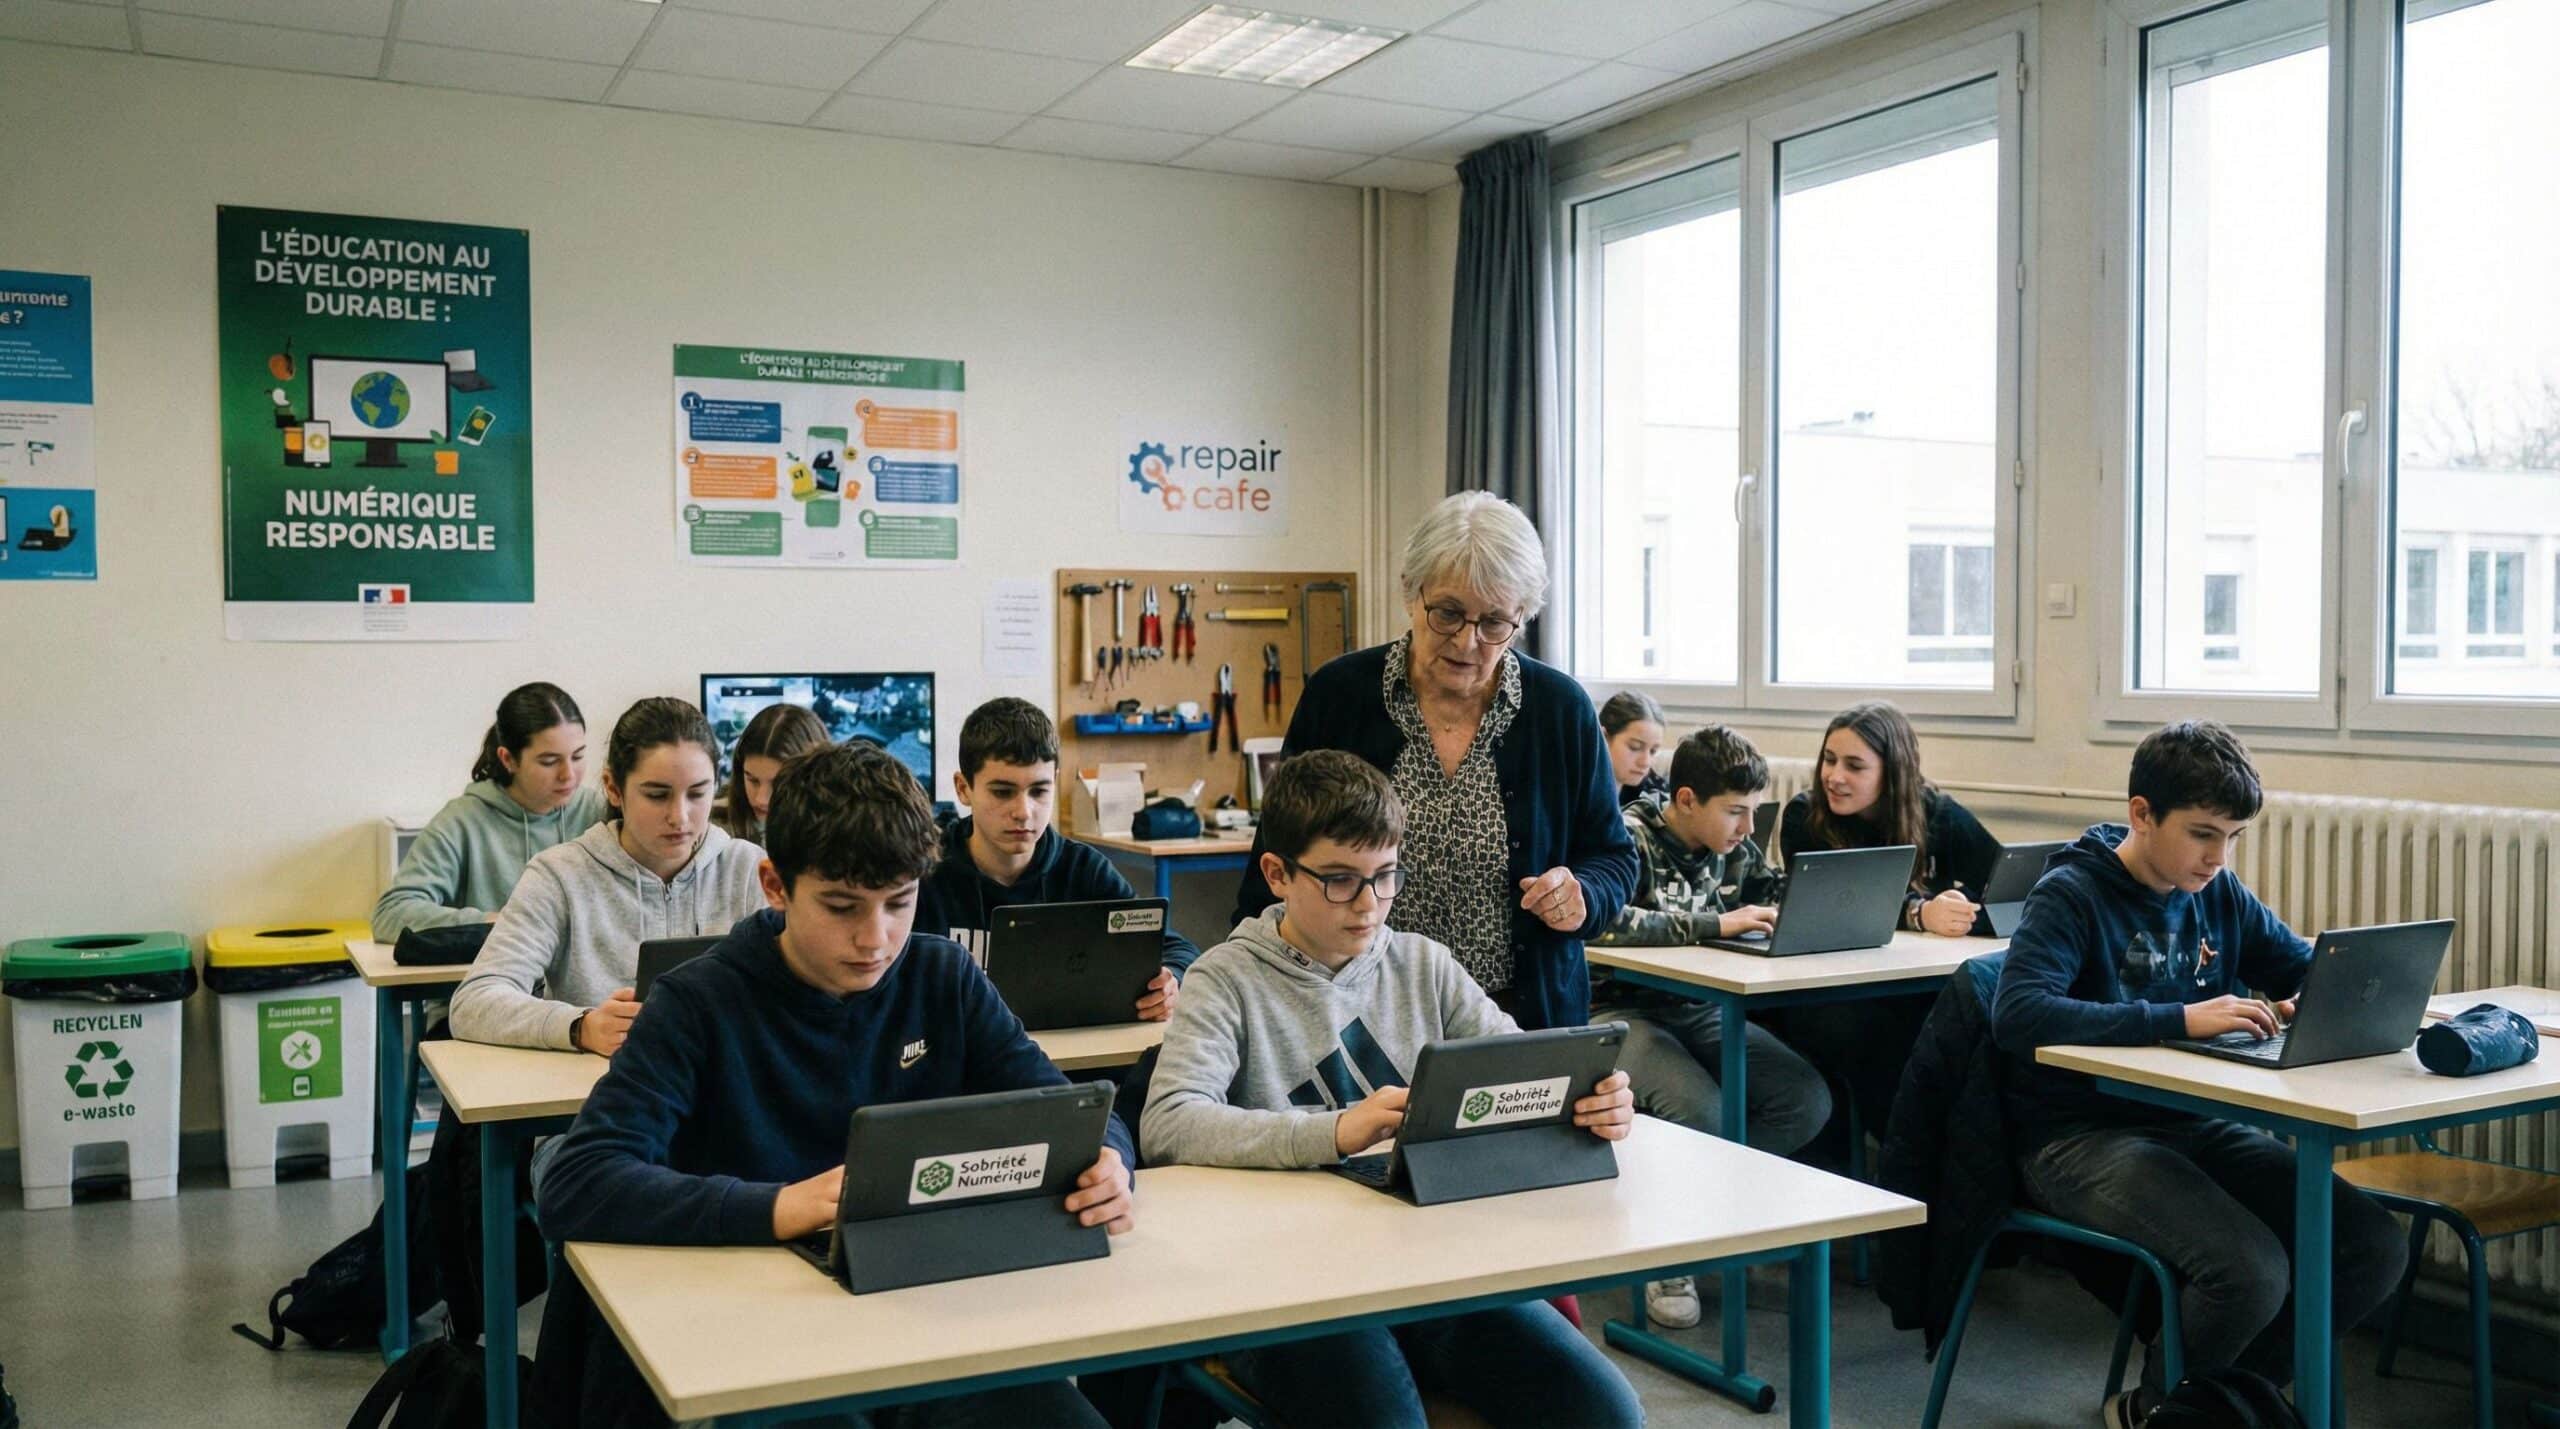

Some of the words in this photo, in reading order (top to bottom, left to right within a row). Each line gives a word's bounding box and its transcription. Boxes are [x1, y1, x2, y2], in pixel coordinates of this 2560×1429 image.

[452, 245, 490, 269] AU
[255, 256, 496, 297] DÉVELOPPEMENT
[306, 292, 436, 321] DURABLE
[1180, 439, 1282, 480] repair
[285, 485, 477, 519] NUMÉRIQUE
[1193, 478, 1271, 512] cafe
[266, 521, 496, 551] RESPONSABLE
[53, 1014, 143, 1034] RECYCLEN
[957, 1168, 1041, 1188] Numérique
[960, 1153, 1026, 1174] Sobriété
